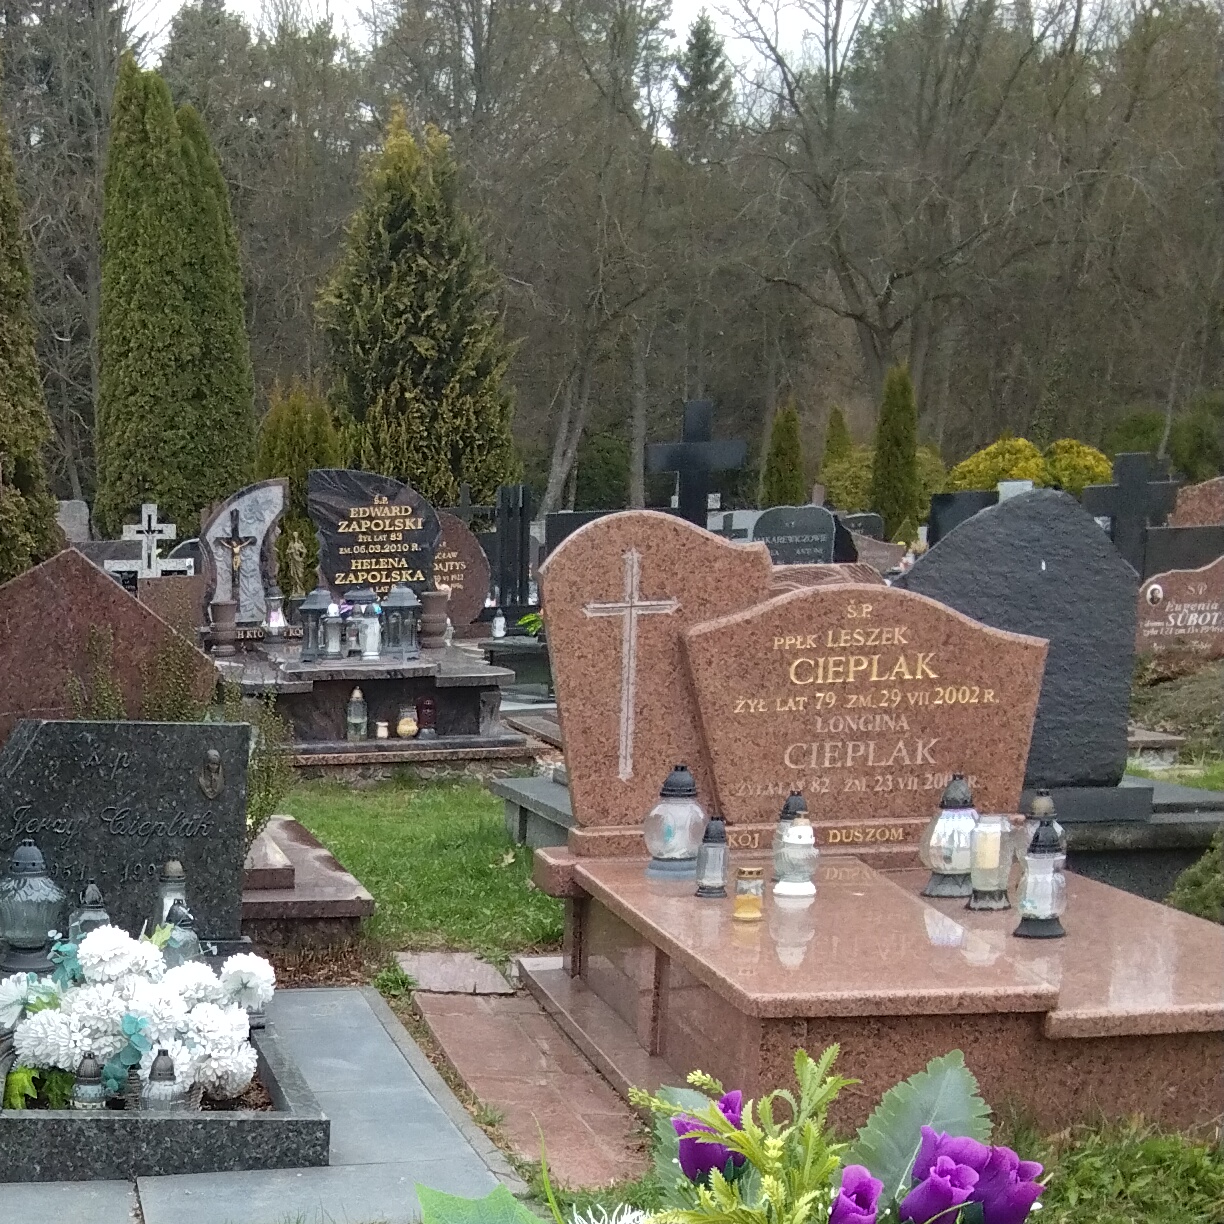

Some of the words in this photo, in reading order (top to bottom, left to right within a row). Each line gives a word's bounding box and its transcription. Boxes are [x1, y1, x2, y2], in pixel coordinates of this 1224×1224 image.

[349, 505, 413, 518] EDWARD
[337, 517, 424, 533] ZAPOLSKI
[350, 558, 409, 570] HELENA
[334, 570, 426, 585] ZAPOLSKA
[773, 633, 818, 650] PPŁK
[825, 626, 909, 648] LESZEK
[788, 652, 940, 686] CIEPLAK
[733, 695, 768, 714] ŻYŁ
[775, 696, 808, 712] LAT
[815, 691, 837, 710] 79
[879, 689, 903, 708] 29
[906, 690, 932, 706] VII
[933, 685, 980, 705] 2002
[982, 688, 1001, 704] R.
[815, 711, 911, 733] LONGINA
[783, 737, 942, 770] CIEPLAK
[809, 775, 830, 793] 82
[874, 774, 894, 793] 23
[896, 775, 918, 790] VII
[924, 772, 954, 790] 200
[100, 805, 213, 847] Cieplak
[828, 827, 905, 844] DUSZOM
